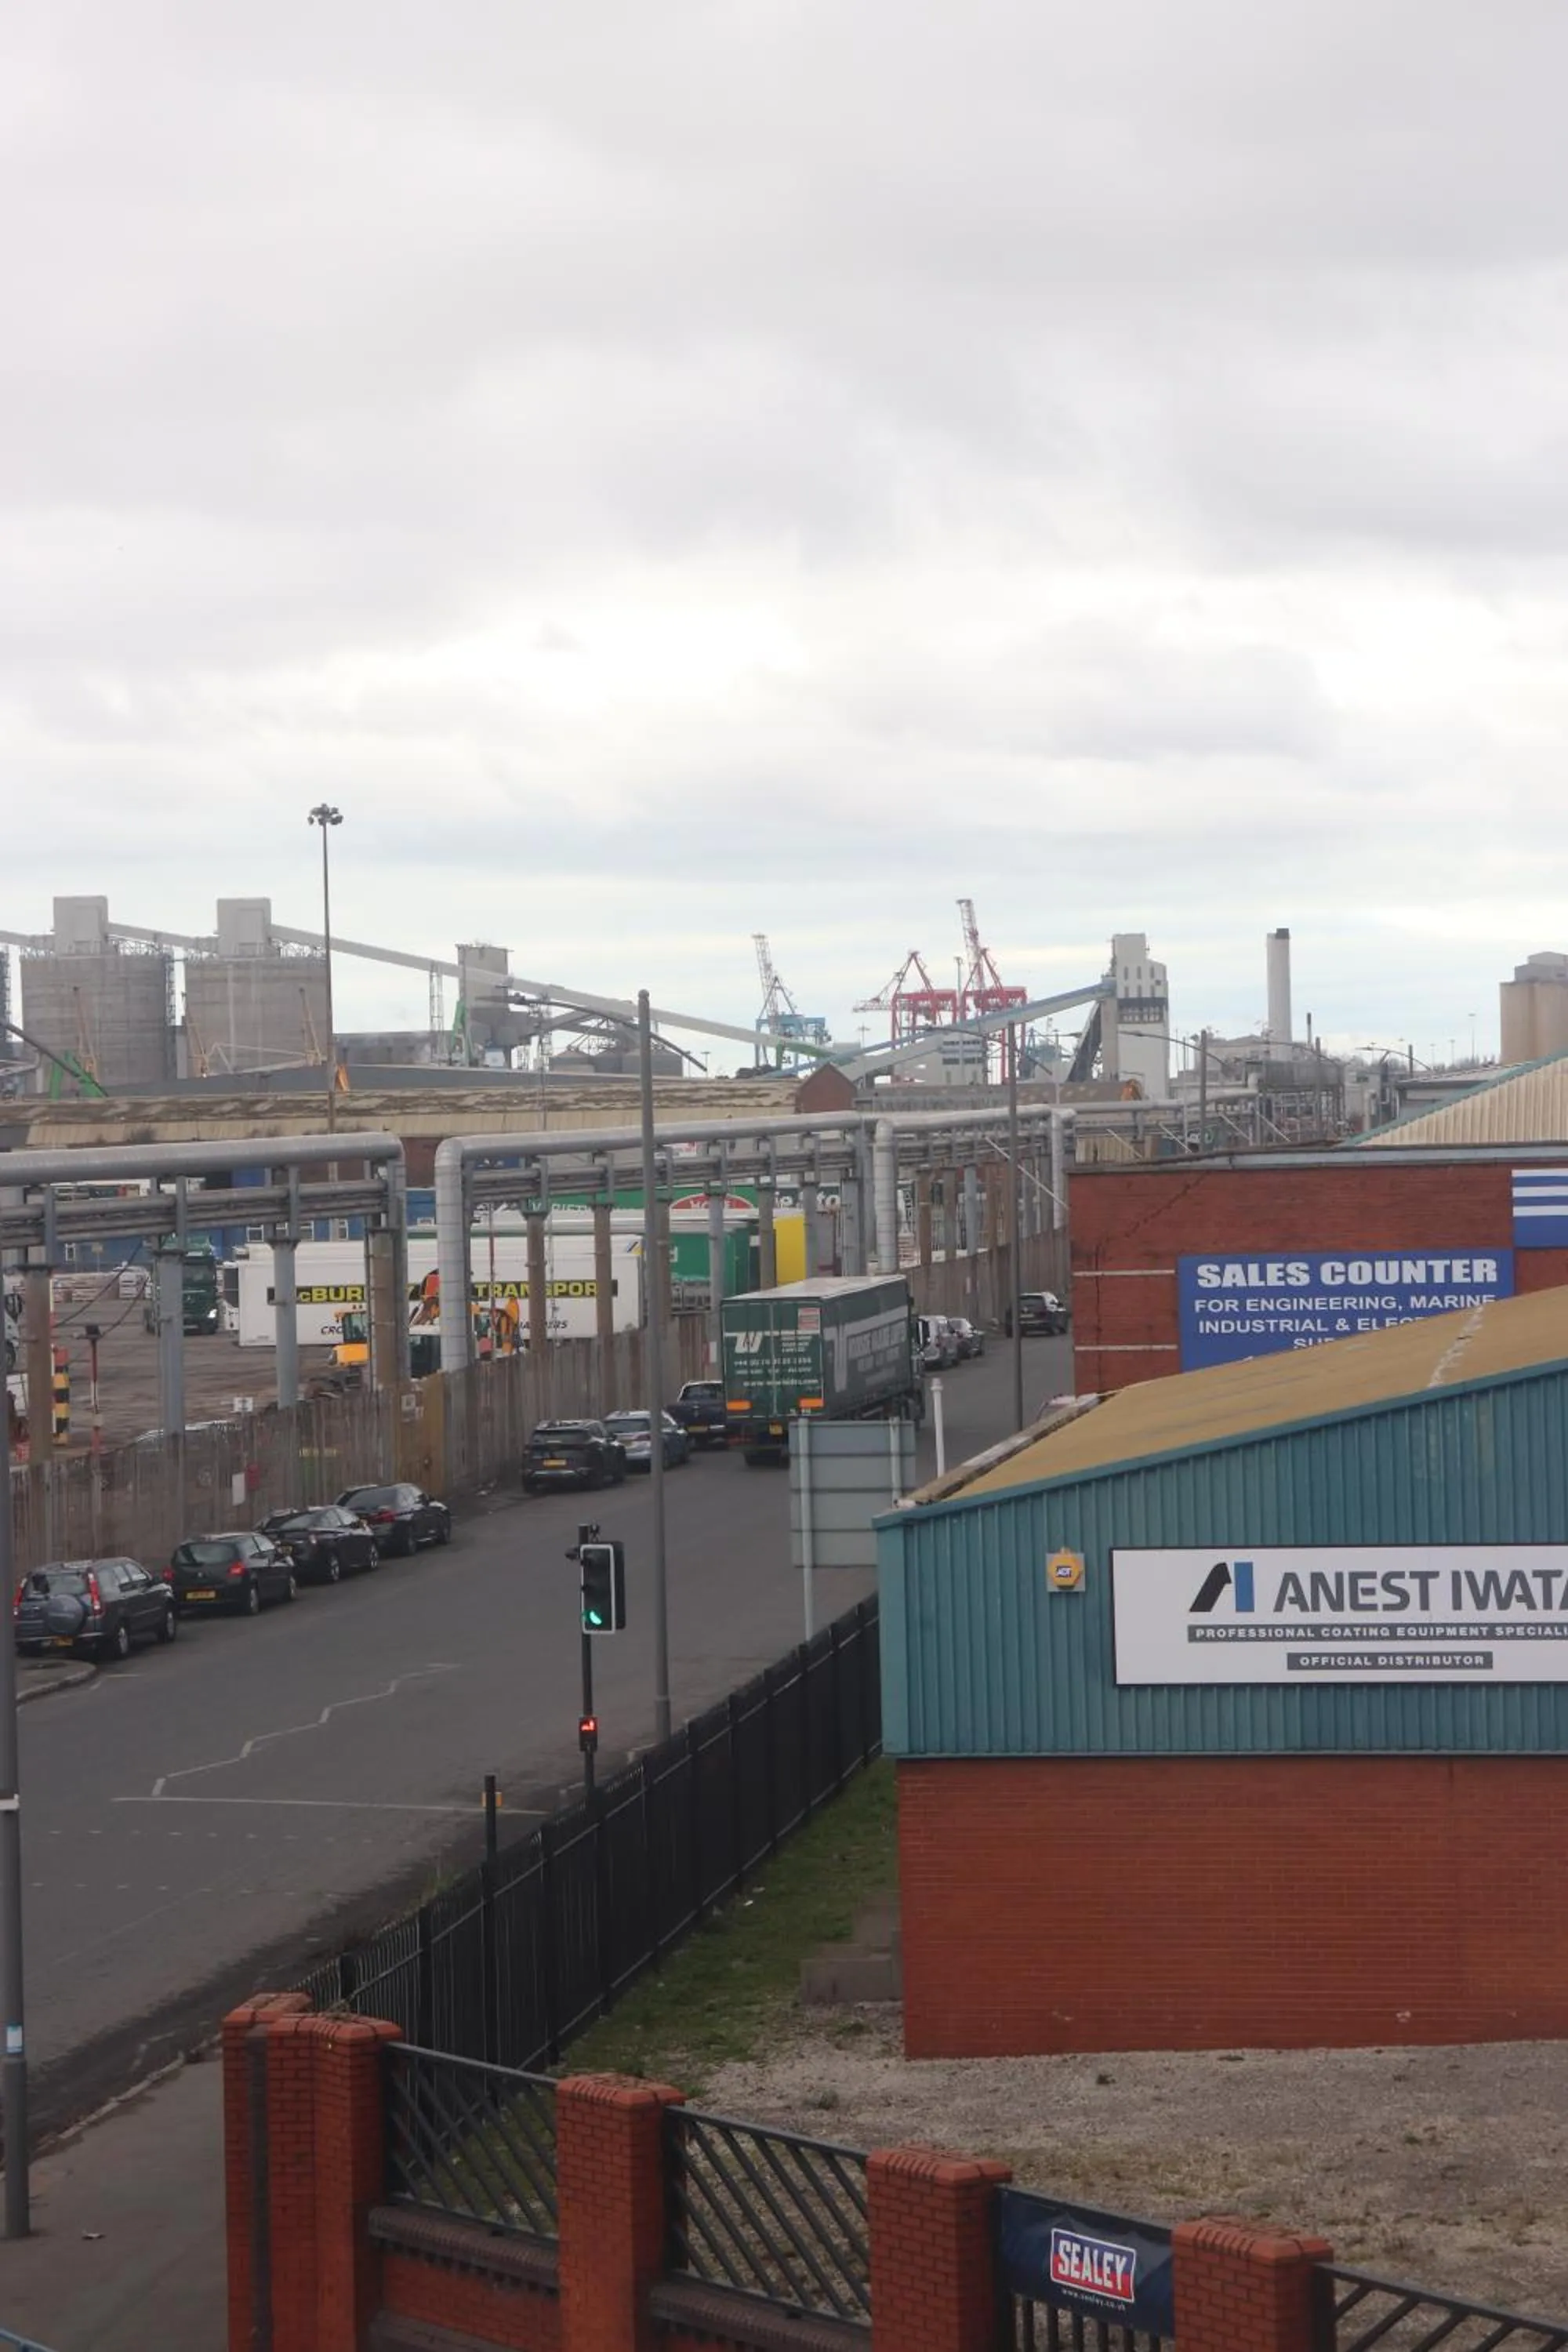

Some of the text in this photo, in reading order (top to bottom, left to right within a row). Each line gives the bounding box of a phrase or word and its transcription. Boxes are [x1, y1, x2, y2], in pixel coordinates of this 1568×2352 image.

[1197, 1258, 1498, 1287] SALES COUNTER
[474, 1281, 598, 1298] TRANPOR
[1195, 1298, 1240, 1312] FOR
[1246, 1296, 1403, 1312] ENGINEERING,
[1199, 1319, 1329, 1334] INDUSTRIAL
[1335, 1318, 1350, 1332] &
[1273, 1570, 1440, 1613] ANEST
[1196, 1628, 1315, 1639] PROFESSIONAL
[1321, 1627, 1390, 1638] COATING
[1396, 1626, 1490, 1637] EQUIPMENT
[1300, 1655, 1485, 1667] OFFICIAL DISTRIBUTOR
[1057, 2239, 1127, 2292] SEALEY
